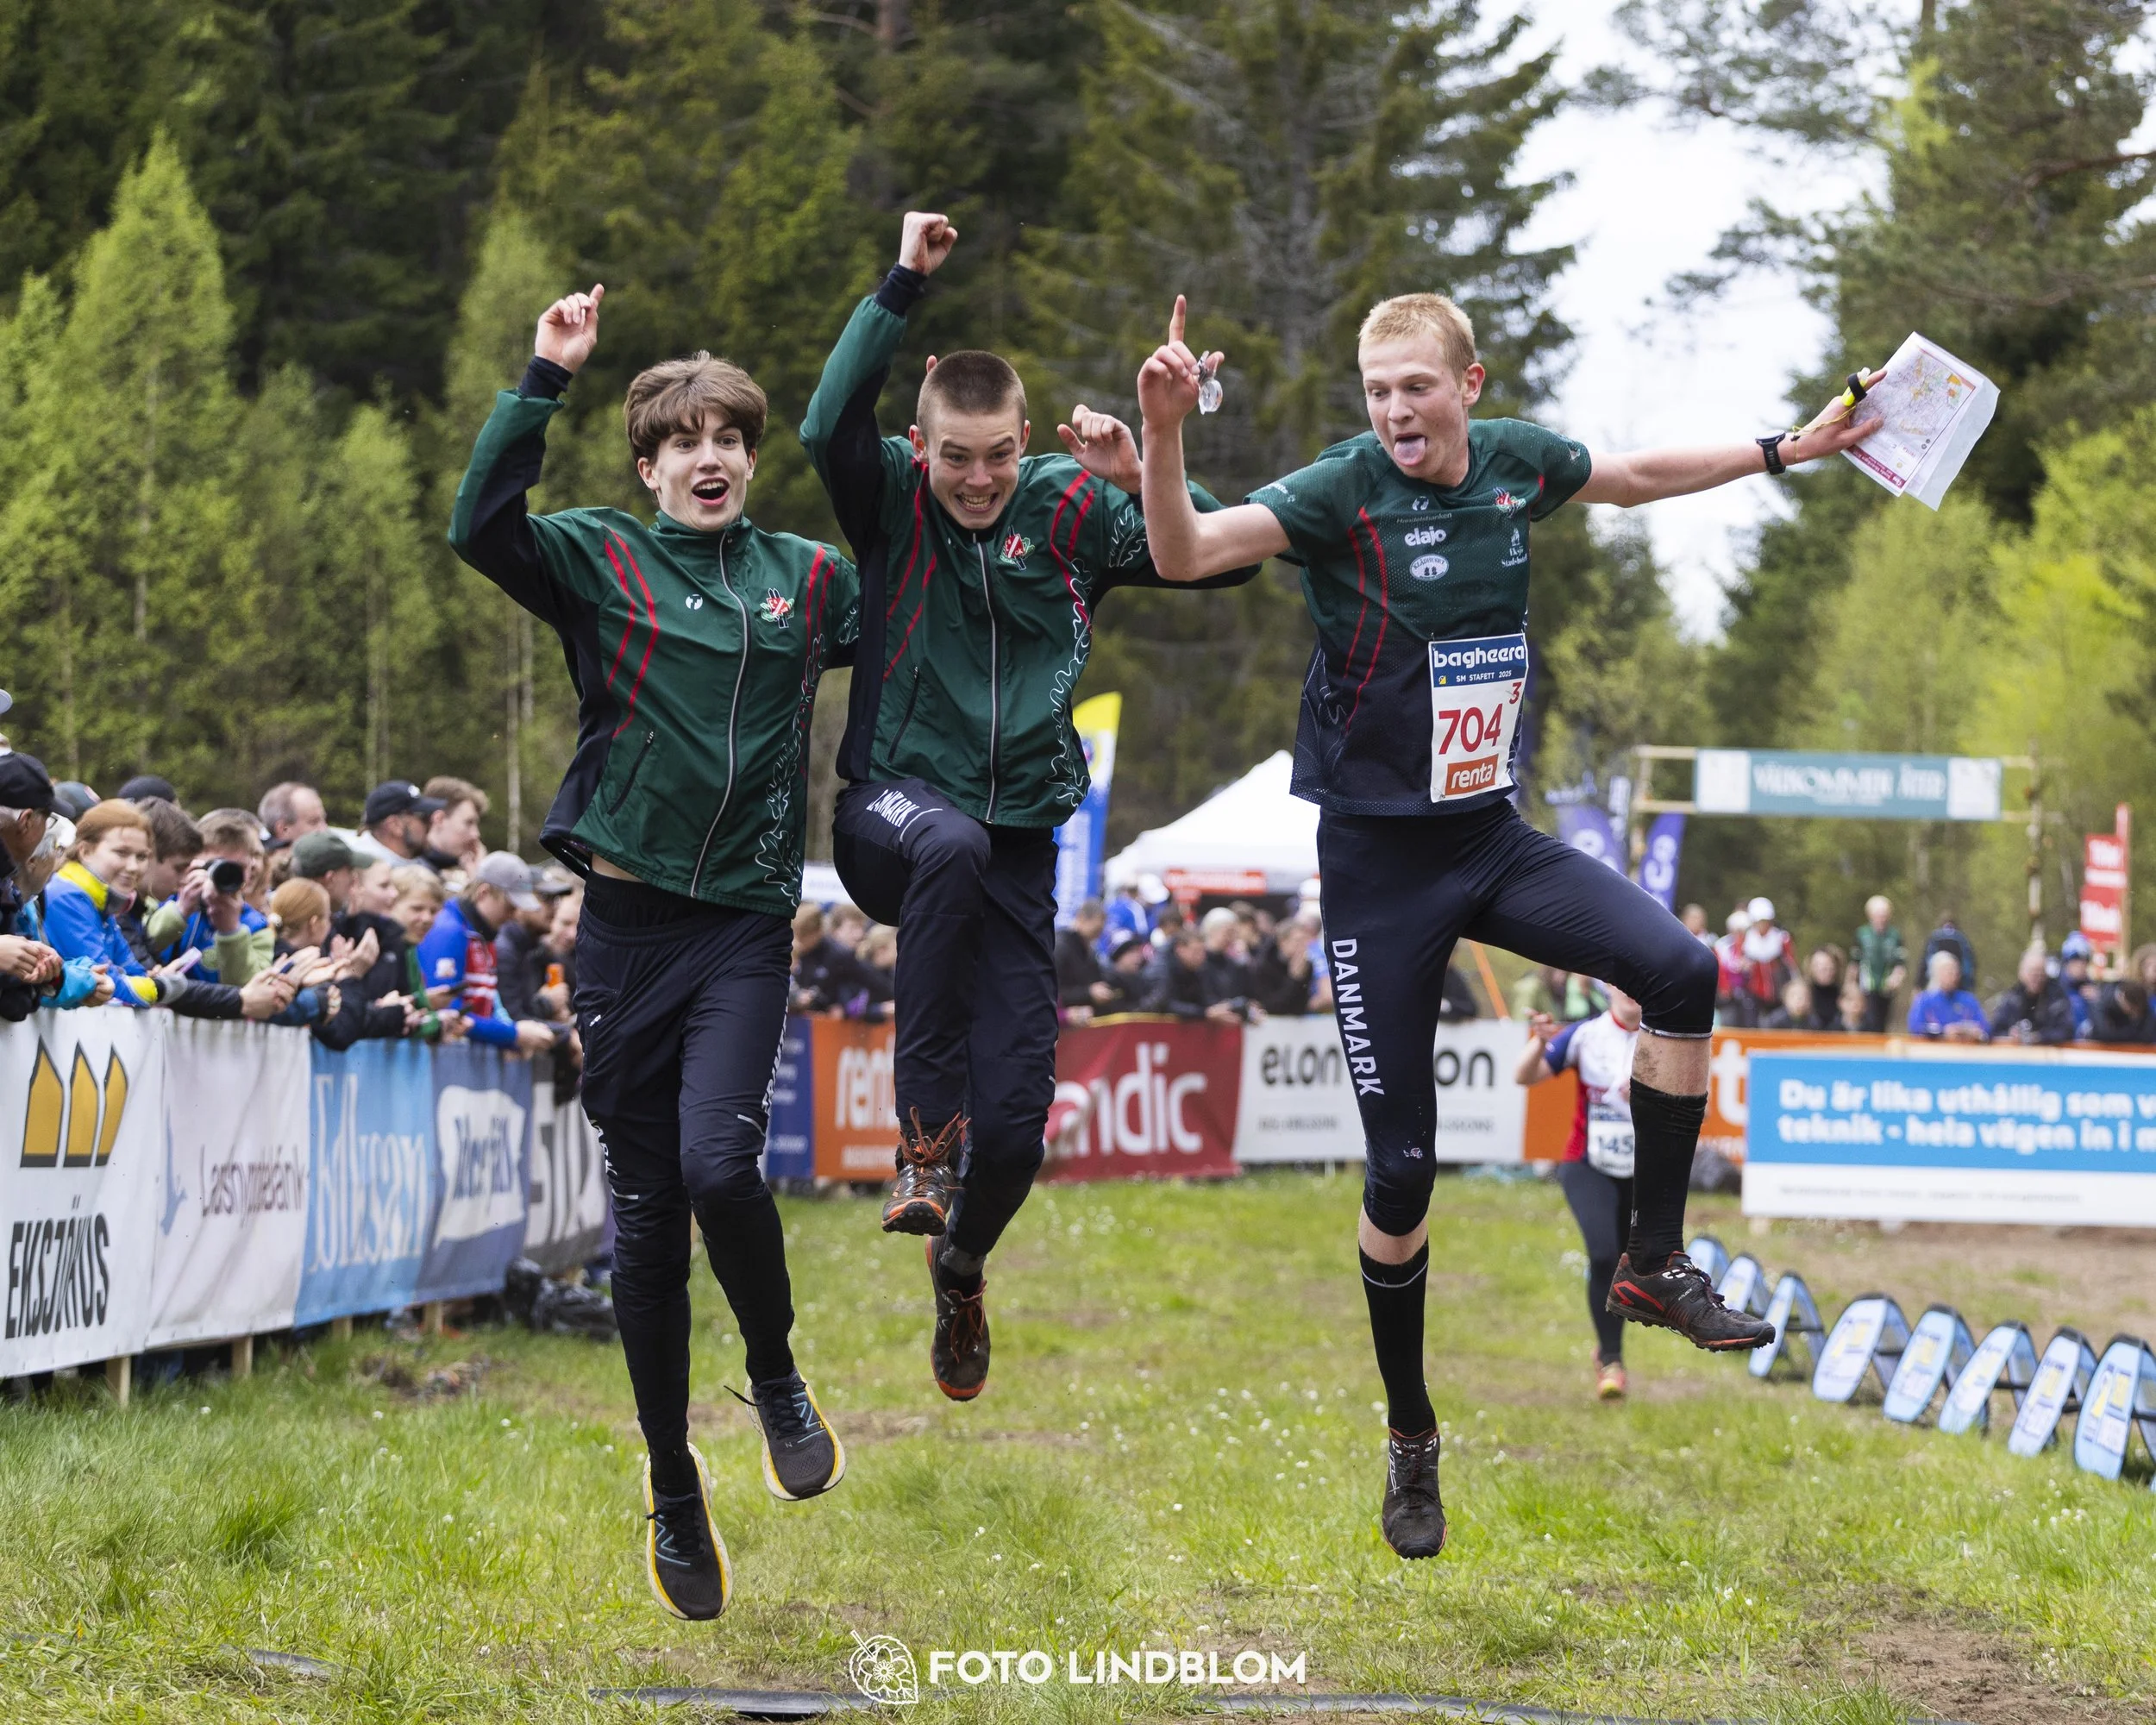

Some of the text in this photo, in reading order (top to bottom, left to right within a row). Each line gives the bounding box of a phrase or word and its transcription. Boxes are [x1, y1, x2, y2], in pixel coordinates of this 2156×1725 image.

[1404, 526, 1447, 547] elajo
[1433, 645, 1525, 668] bagheera
[1456, 669, 1512, 683] SM STAFETT 2025
[1509, 681, 1522, 705] 3
[1438, 703, 1503, 756] 704
[1451, 762, 1494, 788] renta
[1332, 938, 1385, 1096] DANMARK
[1779, 1078, 1827, 1111] Du
[2066, 1091, 2134, 1119] som
[1777, 1113, 1883, 1145] teknik
